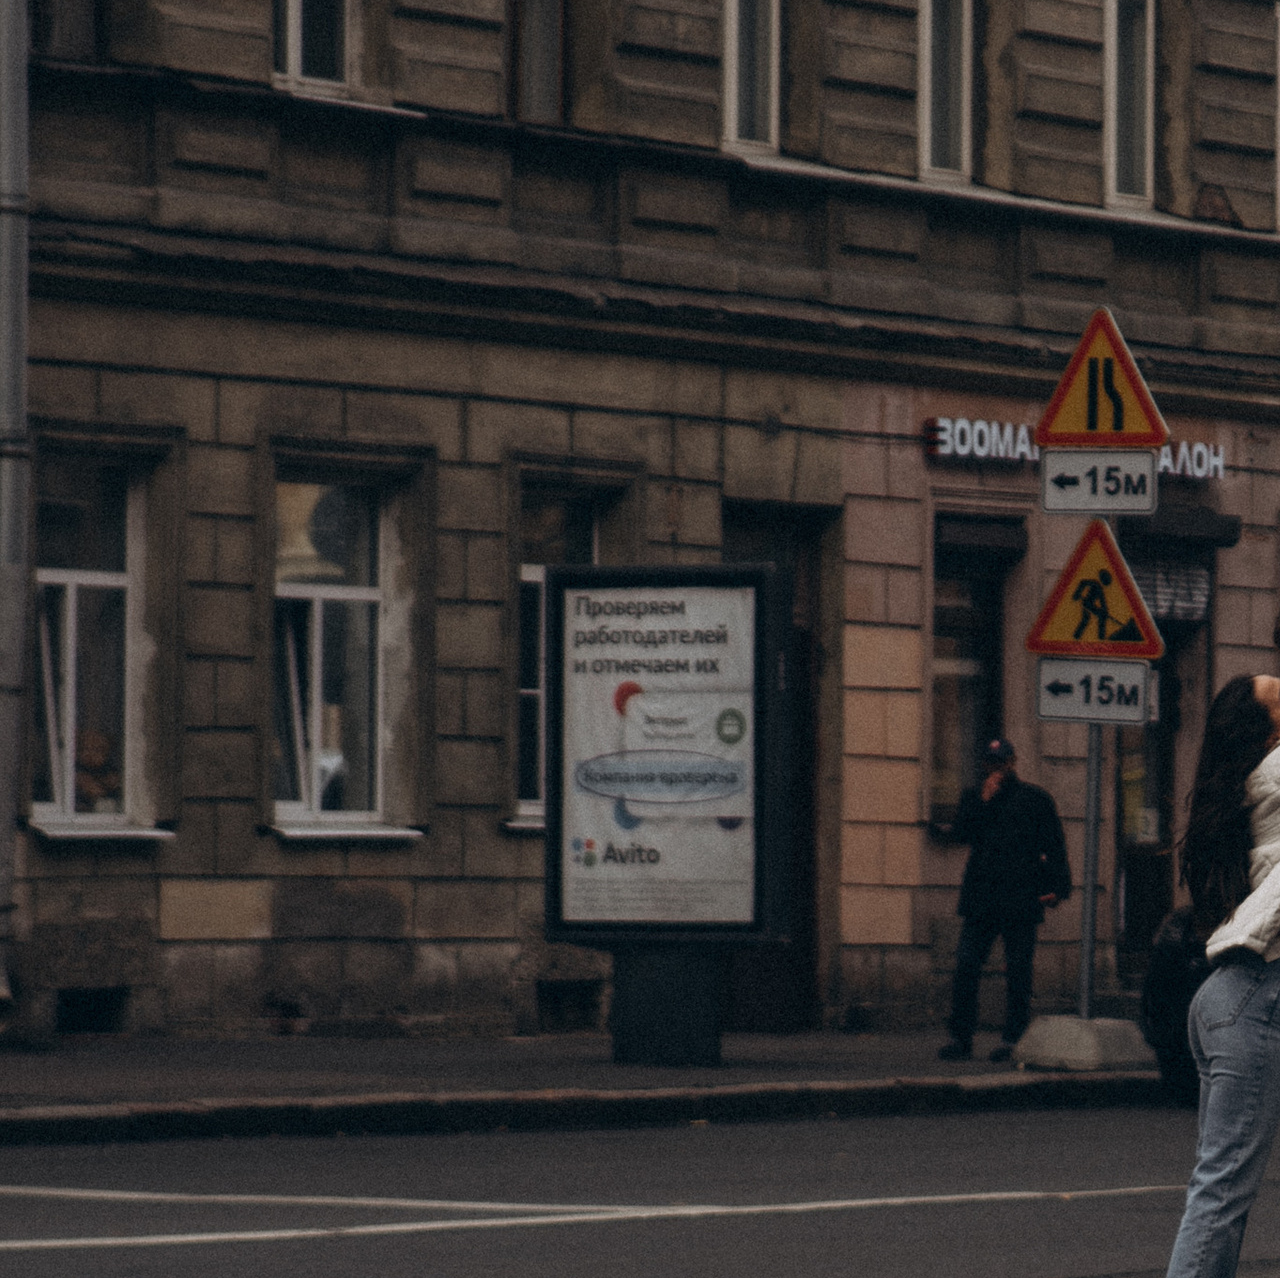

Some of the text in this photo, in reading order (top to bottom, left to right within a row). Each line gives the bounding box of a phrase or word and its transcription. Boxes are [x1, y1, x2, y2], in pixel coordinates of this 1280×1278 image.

[1158, 440, 1225, 480] АЛОН
[575, 596, 686, 619] Проверяем
[573, 625, 728, 648] работодателей
[573, 658, 720, 674] и отмечаем их
[603, 841, 661, 864] Avito
